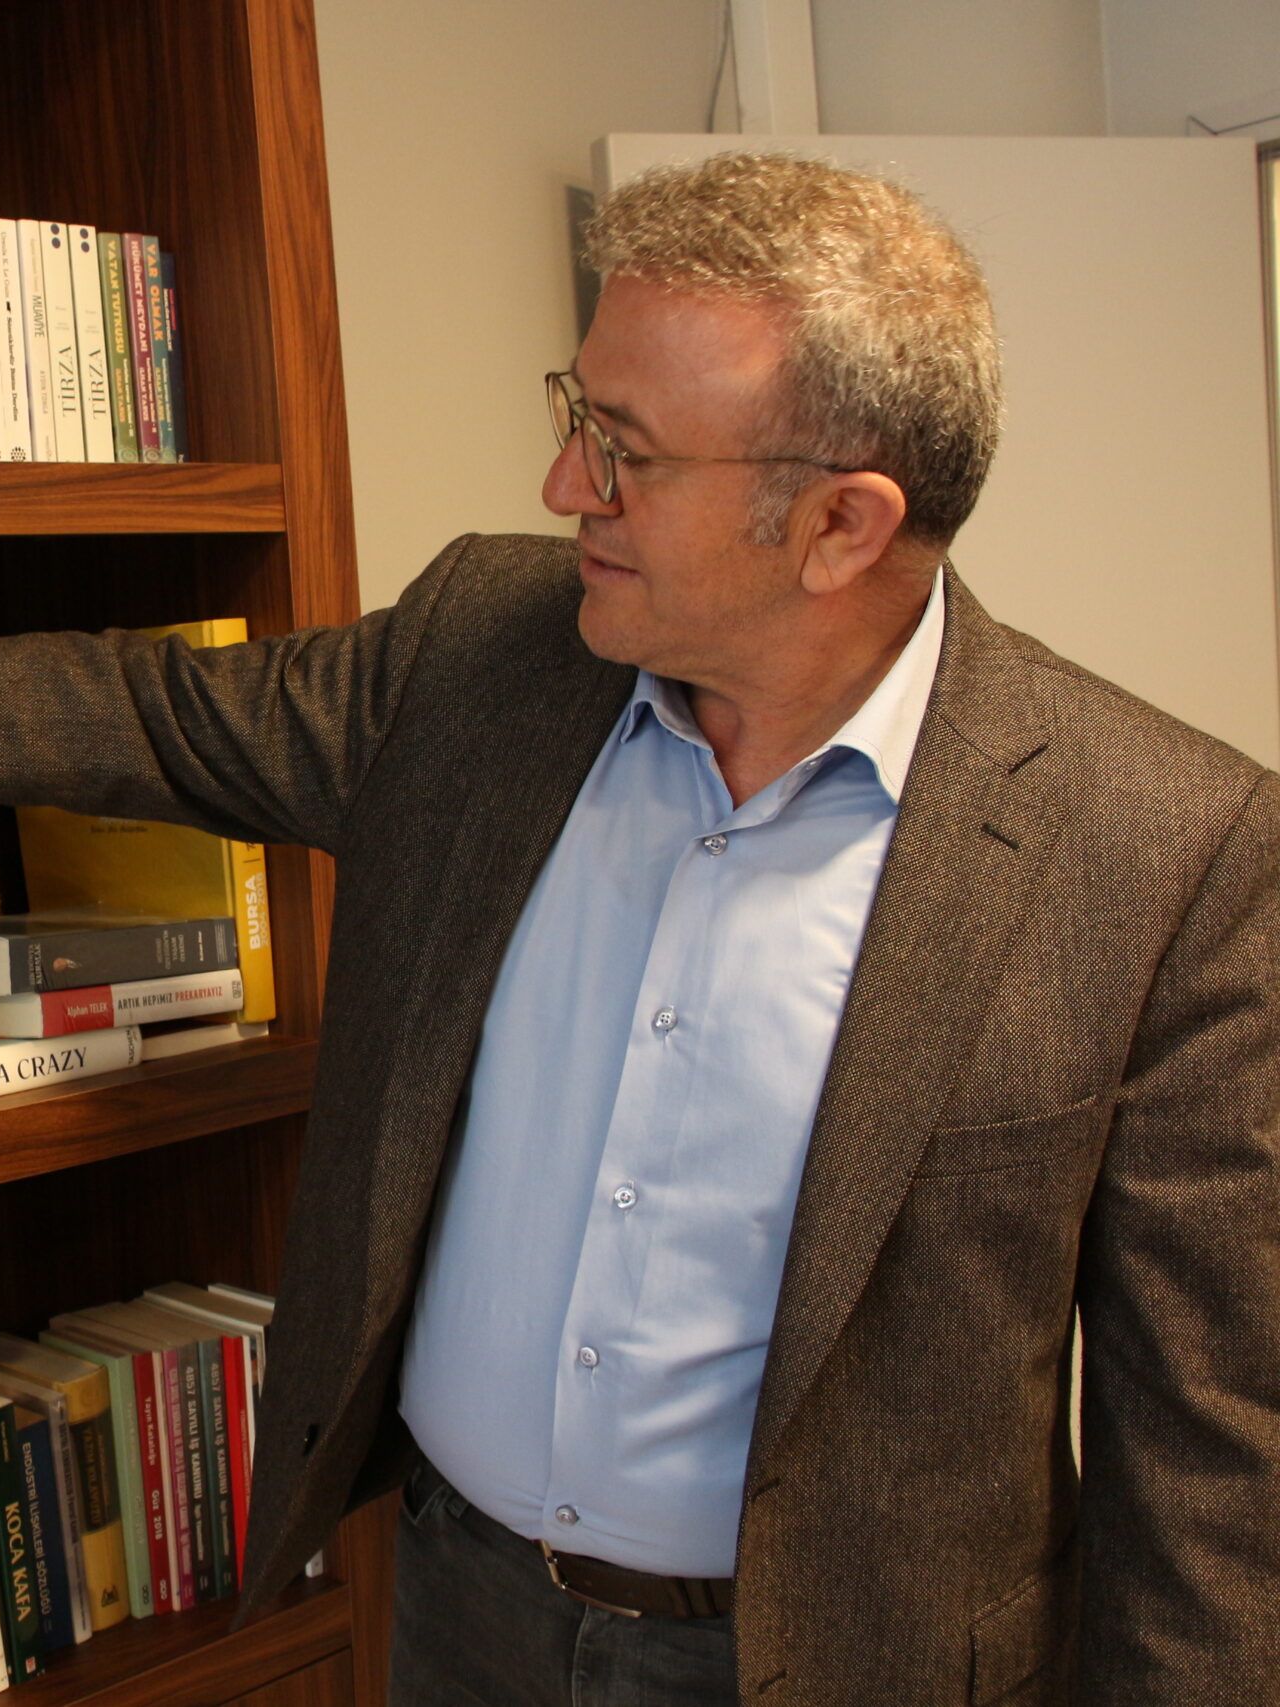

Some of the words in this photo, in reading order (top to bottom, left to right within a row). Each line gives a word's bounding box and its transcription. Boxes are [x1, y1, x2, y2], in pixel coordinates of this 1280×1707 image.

[108, 240, 119, 289] VATAN
[146, 244, 159, 277] VAR
[111, 292, 124, 353] TUTKUSU
[151, 285, 163, 340] OLMAK
[245, 875, 261, 950] BURSA
[118, 997, 139, 1011] ARTIK
[17, 1047, 88, 1081] CRAZY
[5, 1501, 24, 1564] KOCA
[8, 1567, 32, 1622] KAFA
